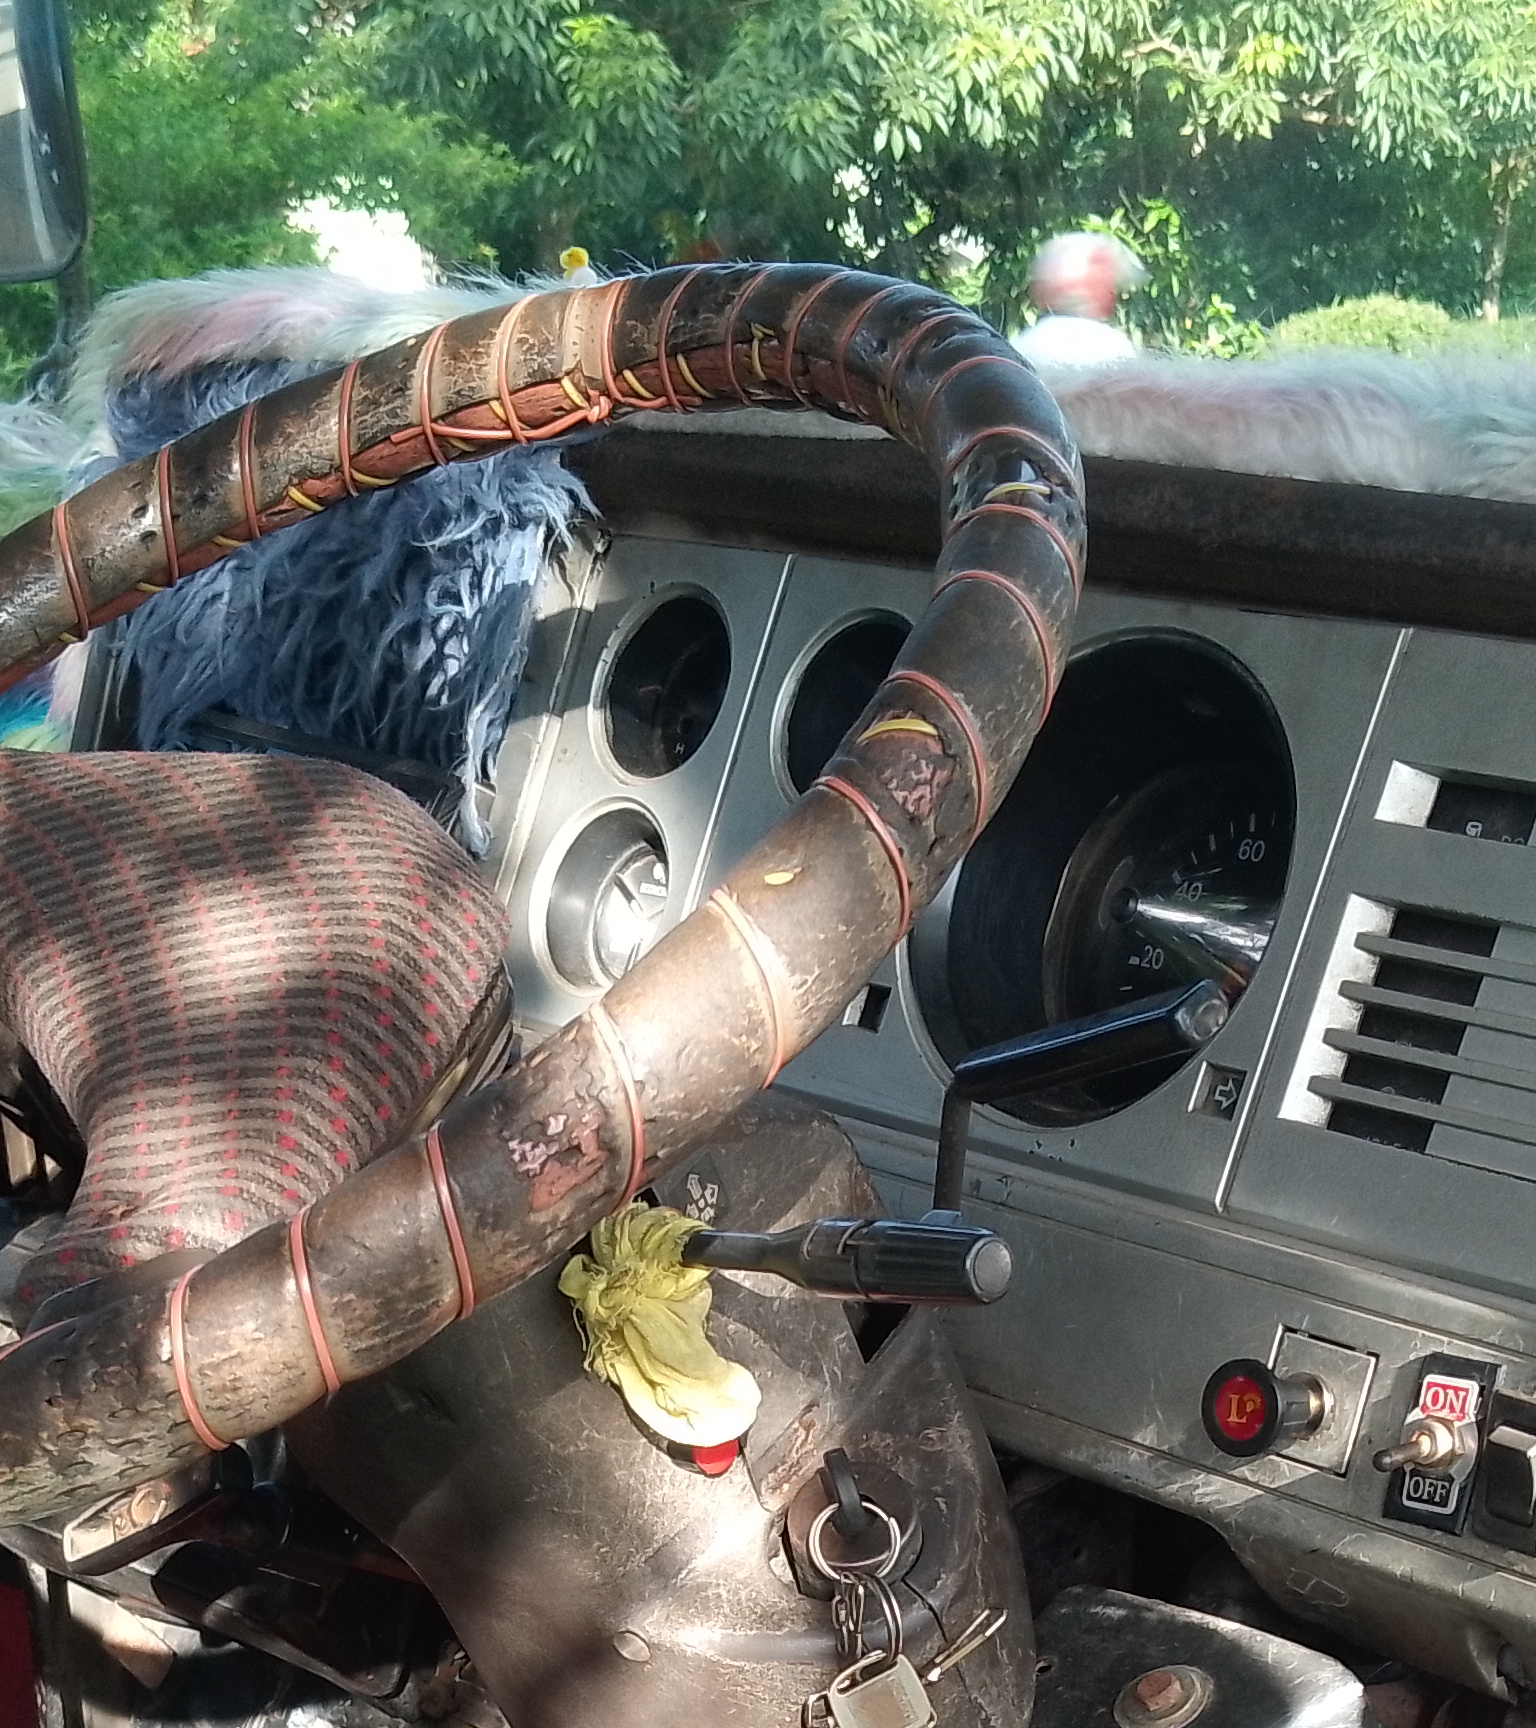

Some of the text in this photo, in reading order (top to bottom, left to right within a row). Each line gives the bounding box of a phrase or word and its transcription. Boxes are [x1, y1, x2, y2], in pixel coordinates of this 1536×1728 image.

[1238, 838, 1265, 862] 60
[1175, 881, 1203, 901] 40
[1140, 945, 1164, 970] 20
[1425, 1386, 1467, 1415] ON
[1409, 1476, 1450, 1503] OFF
